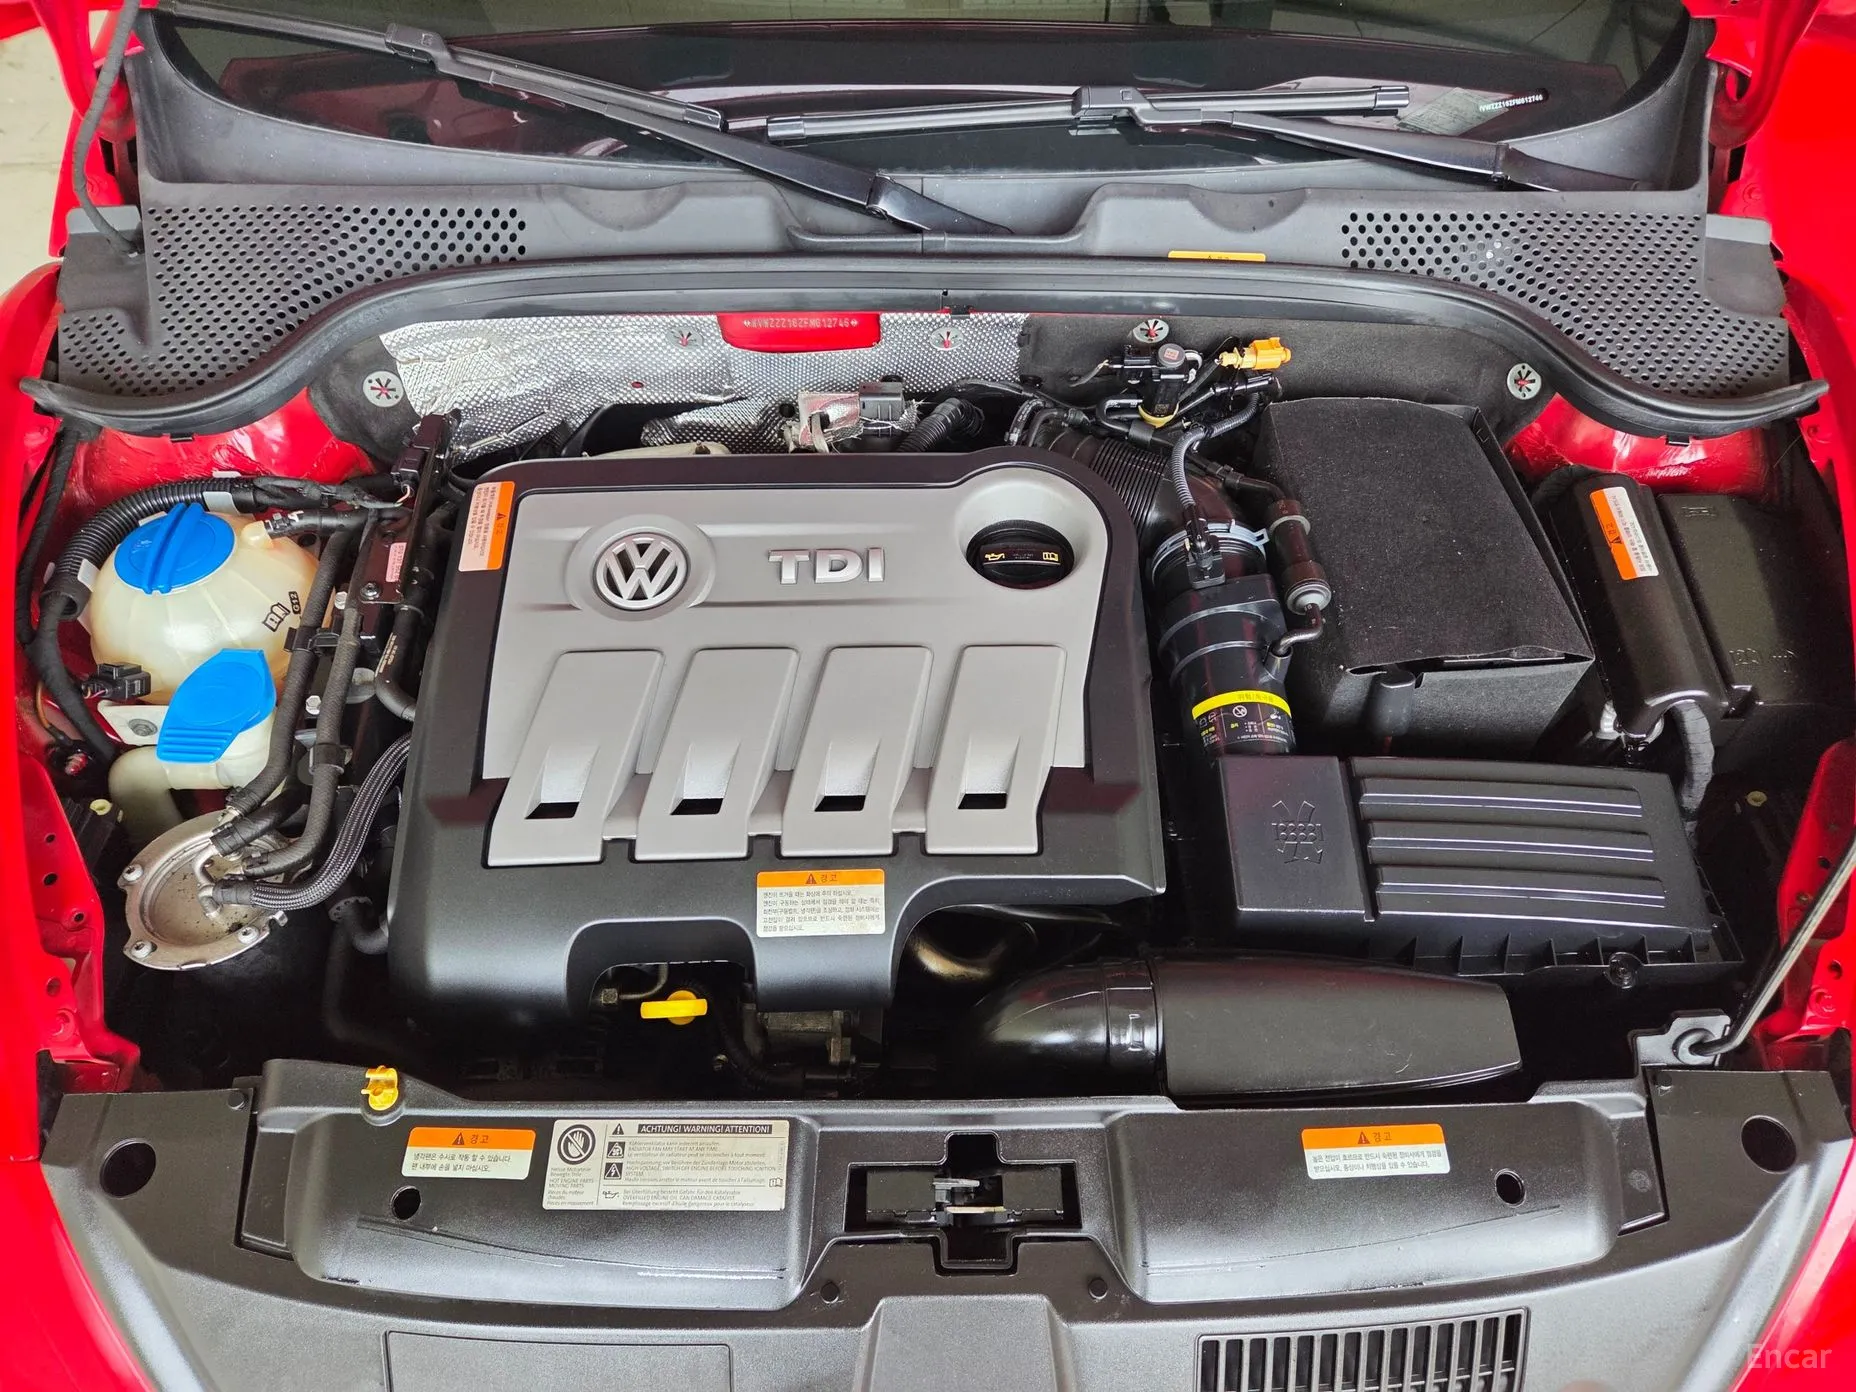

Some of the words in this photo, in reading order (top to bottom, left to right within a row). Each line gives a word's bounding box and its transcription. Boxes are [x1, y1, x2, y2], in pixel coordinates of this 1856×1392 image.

[768, 547, 885, 584] TDI
[820, 873, 838, 883] 경고
[640, 1124, 682, 1133] ACHTUNG!
[683, 1124, 723, 1133] WARNING!
[724, 1125, 770, 1133] ATTENTION!
[469, 1133, 490, 1145] 경고
[1372, 1131, 1393, 1143] 경고
